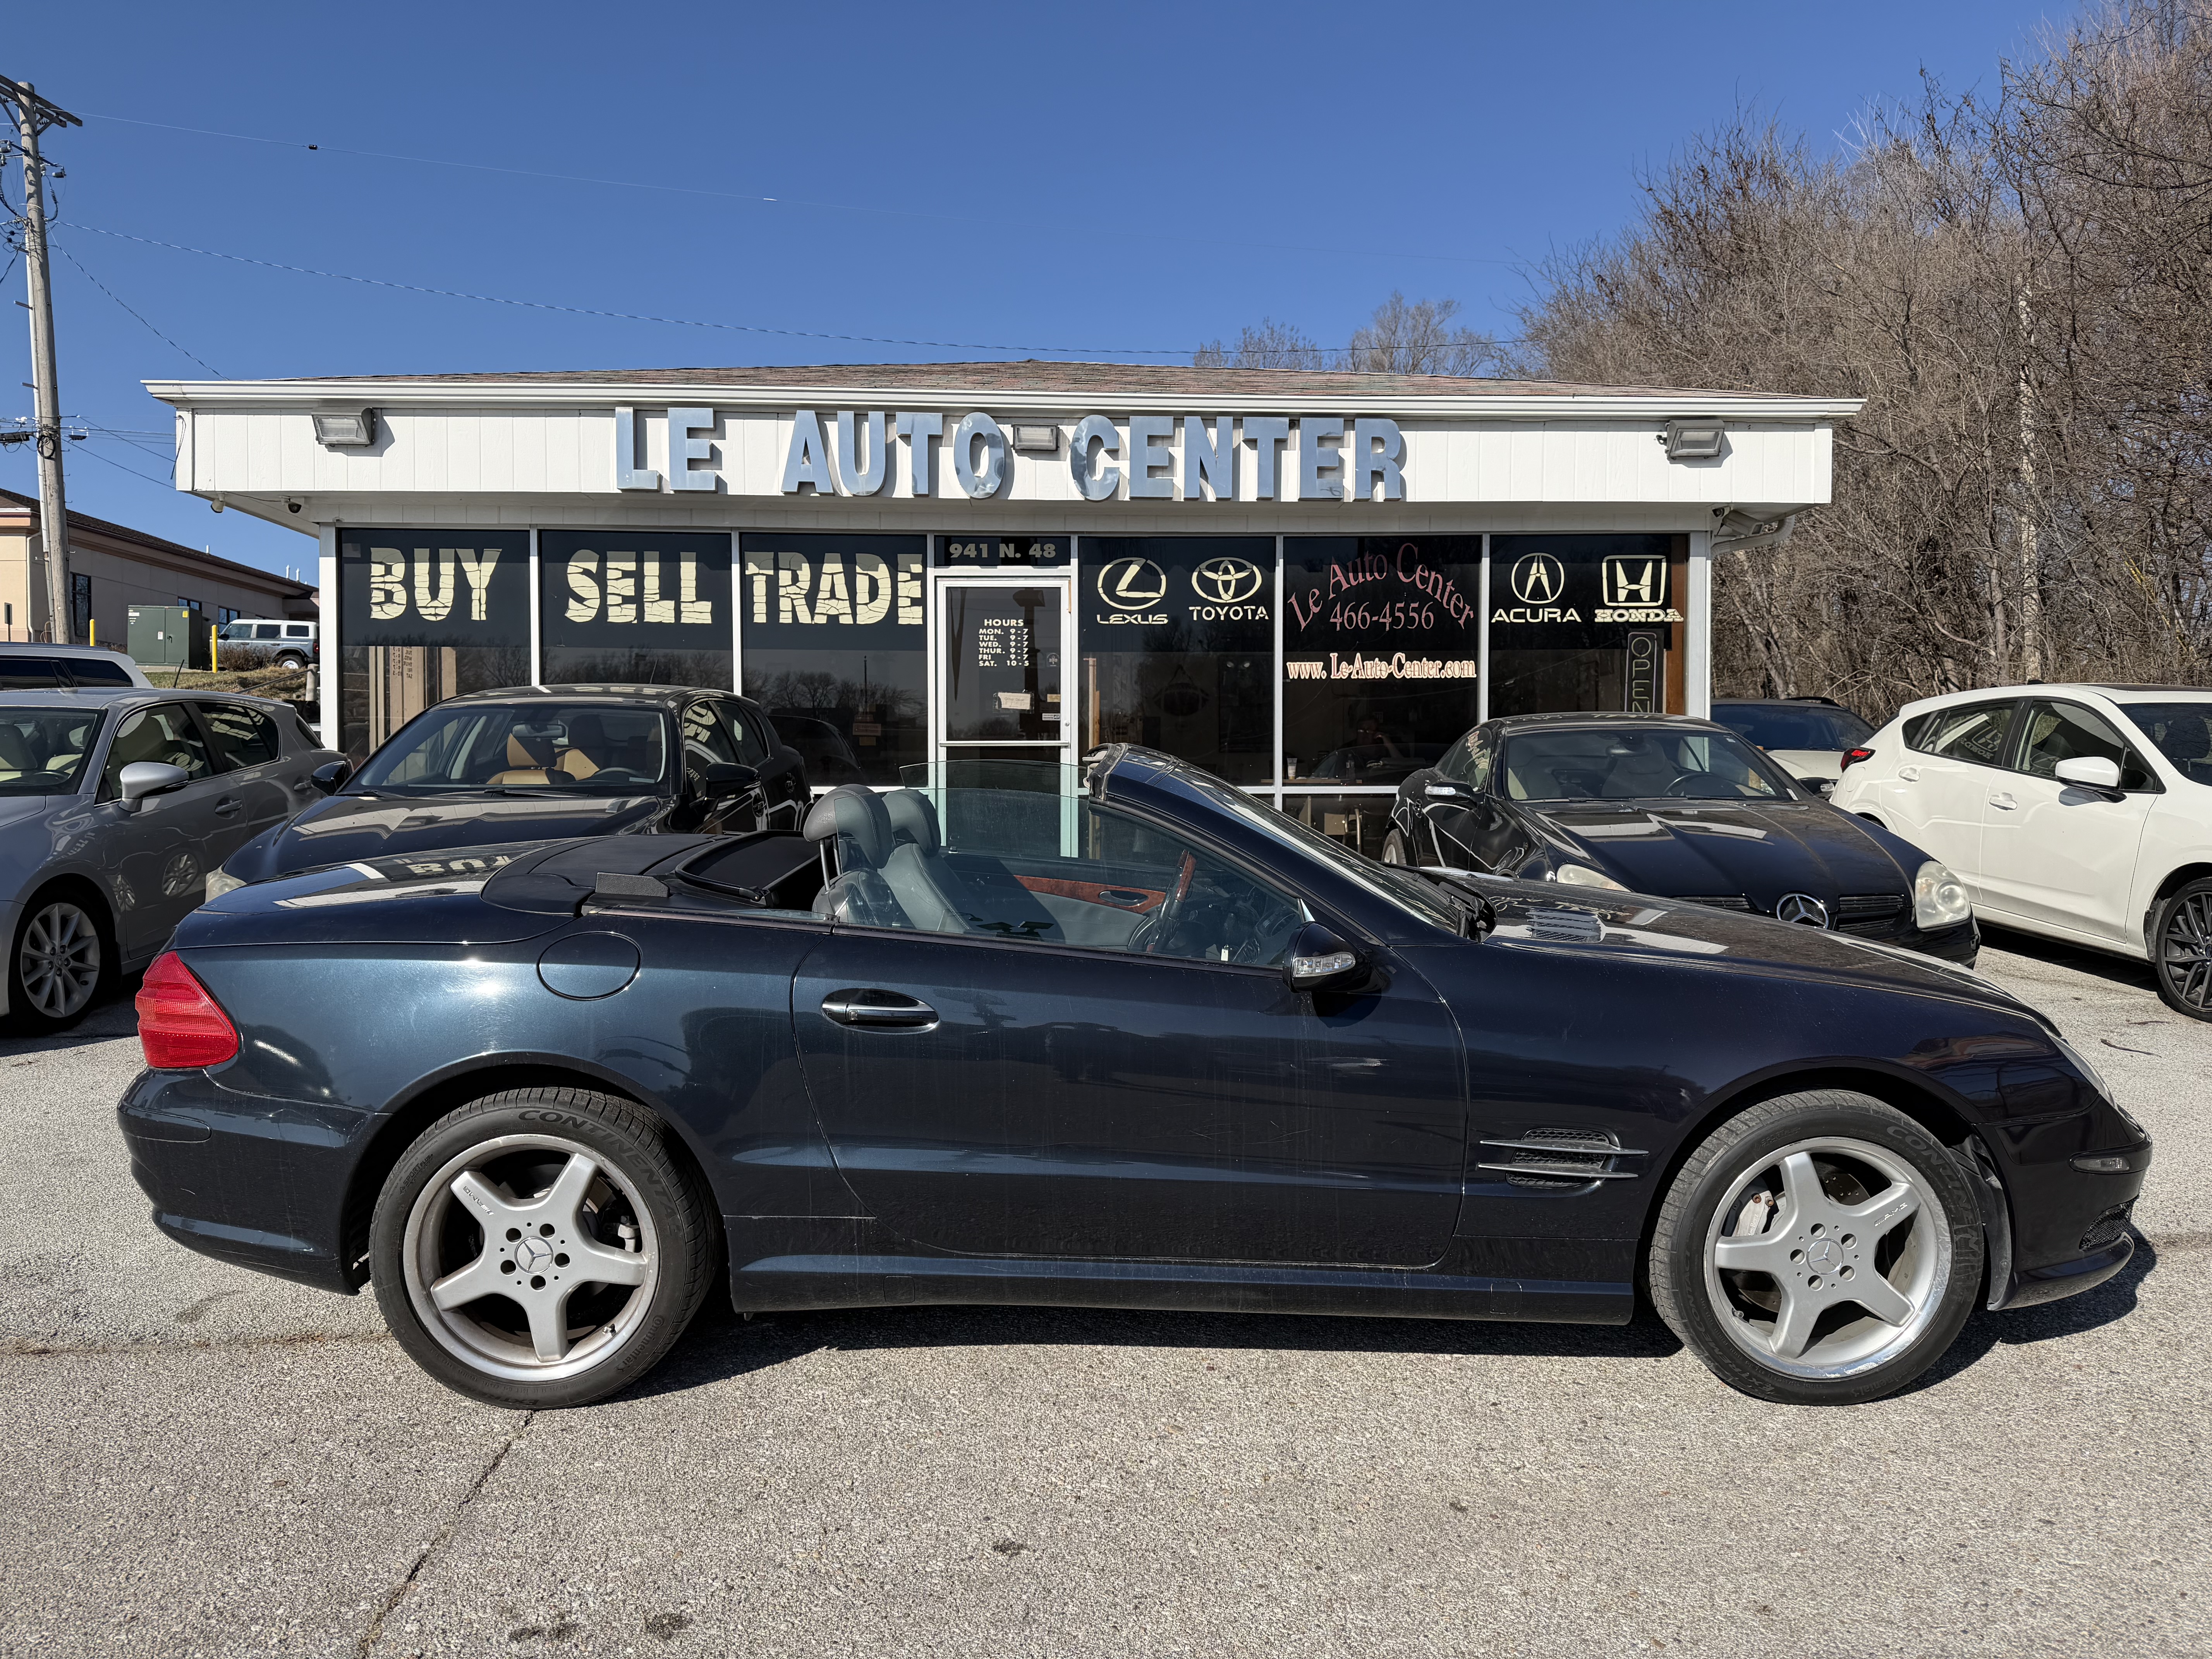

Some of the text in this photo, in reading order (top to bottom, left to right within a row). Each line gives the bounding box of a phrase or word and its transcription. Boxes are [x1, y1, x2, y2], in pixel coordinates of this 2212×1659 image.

[615, 407, 1402, 503] LE AUTO CENTER
[949, 543, 1056, 558] 941 N. 48
[370, 547, 923, 624] BUY SELL TRADE
[1288, 543, 1474, 632] Le Auto Center
[1096, 614, 1169, 624] LEXUS
[1188, 605, 1269, 621] TOYOTA
[1329, 601, 1434, 631] 466-4556
[1491, 608, 1582, 623] ACURA
[1594, 608, 1684, 622] HONDA
[518, 1109, 678, 1236] CONTINENTA
